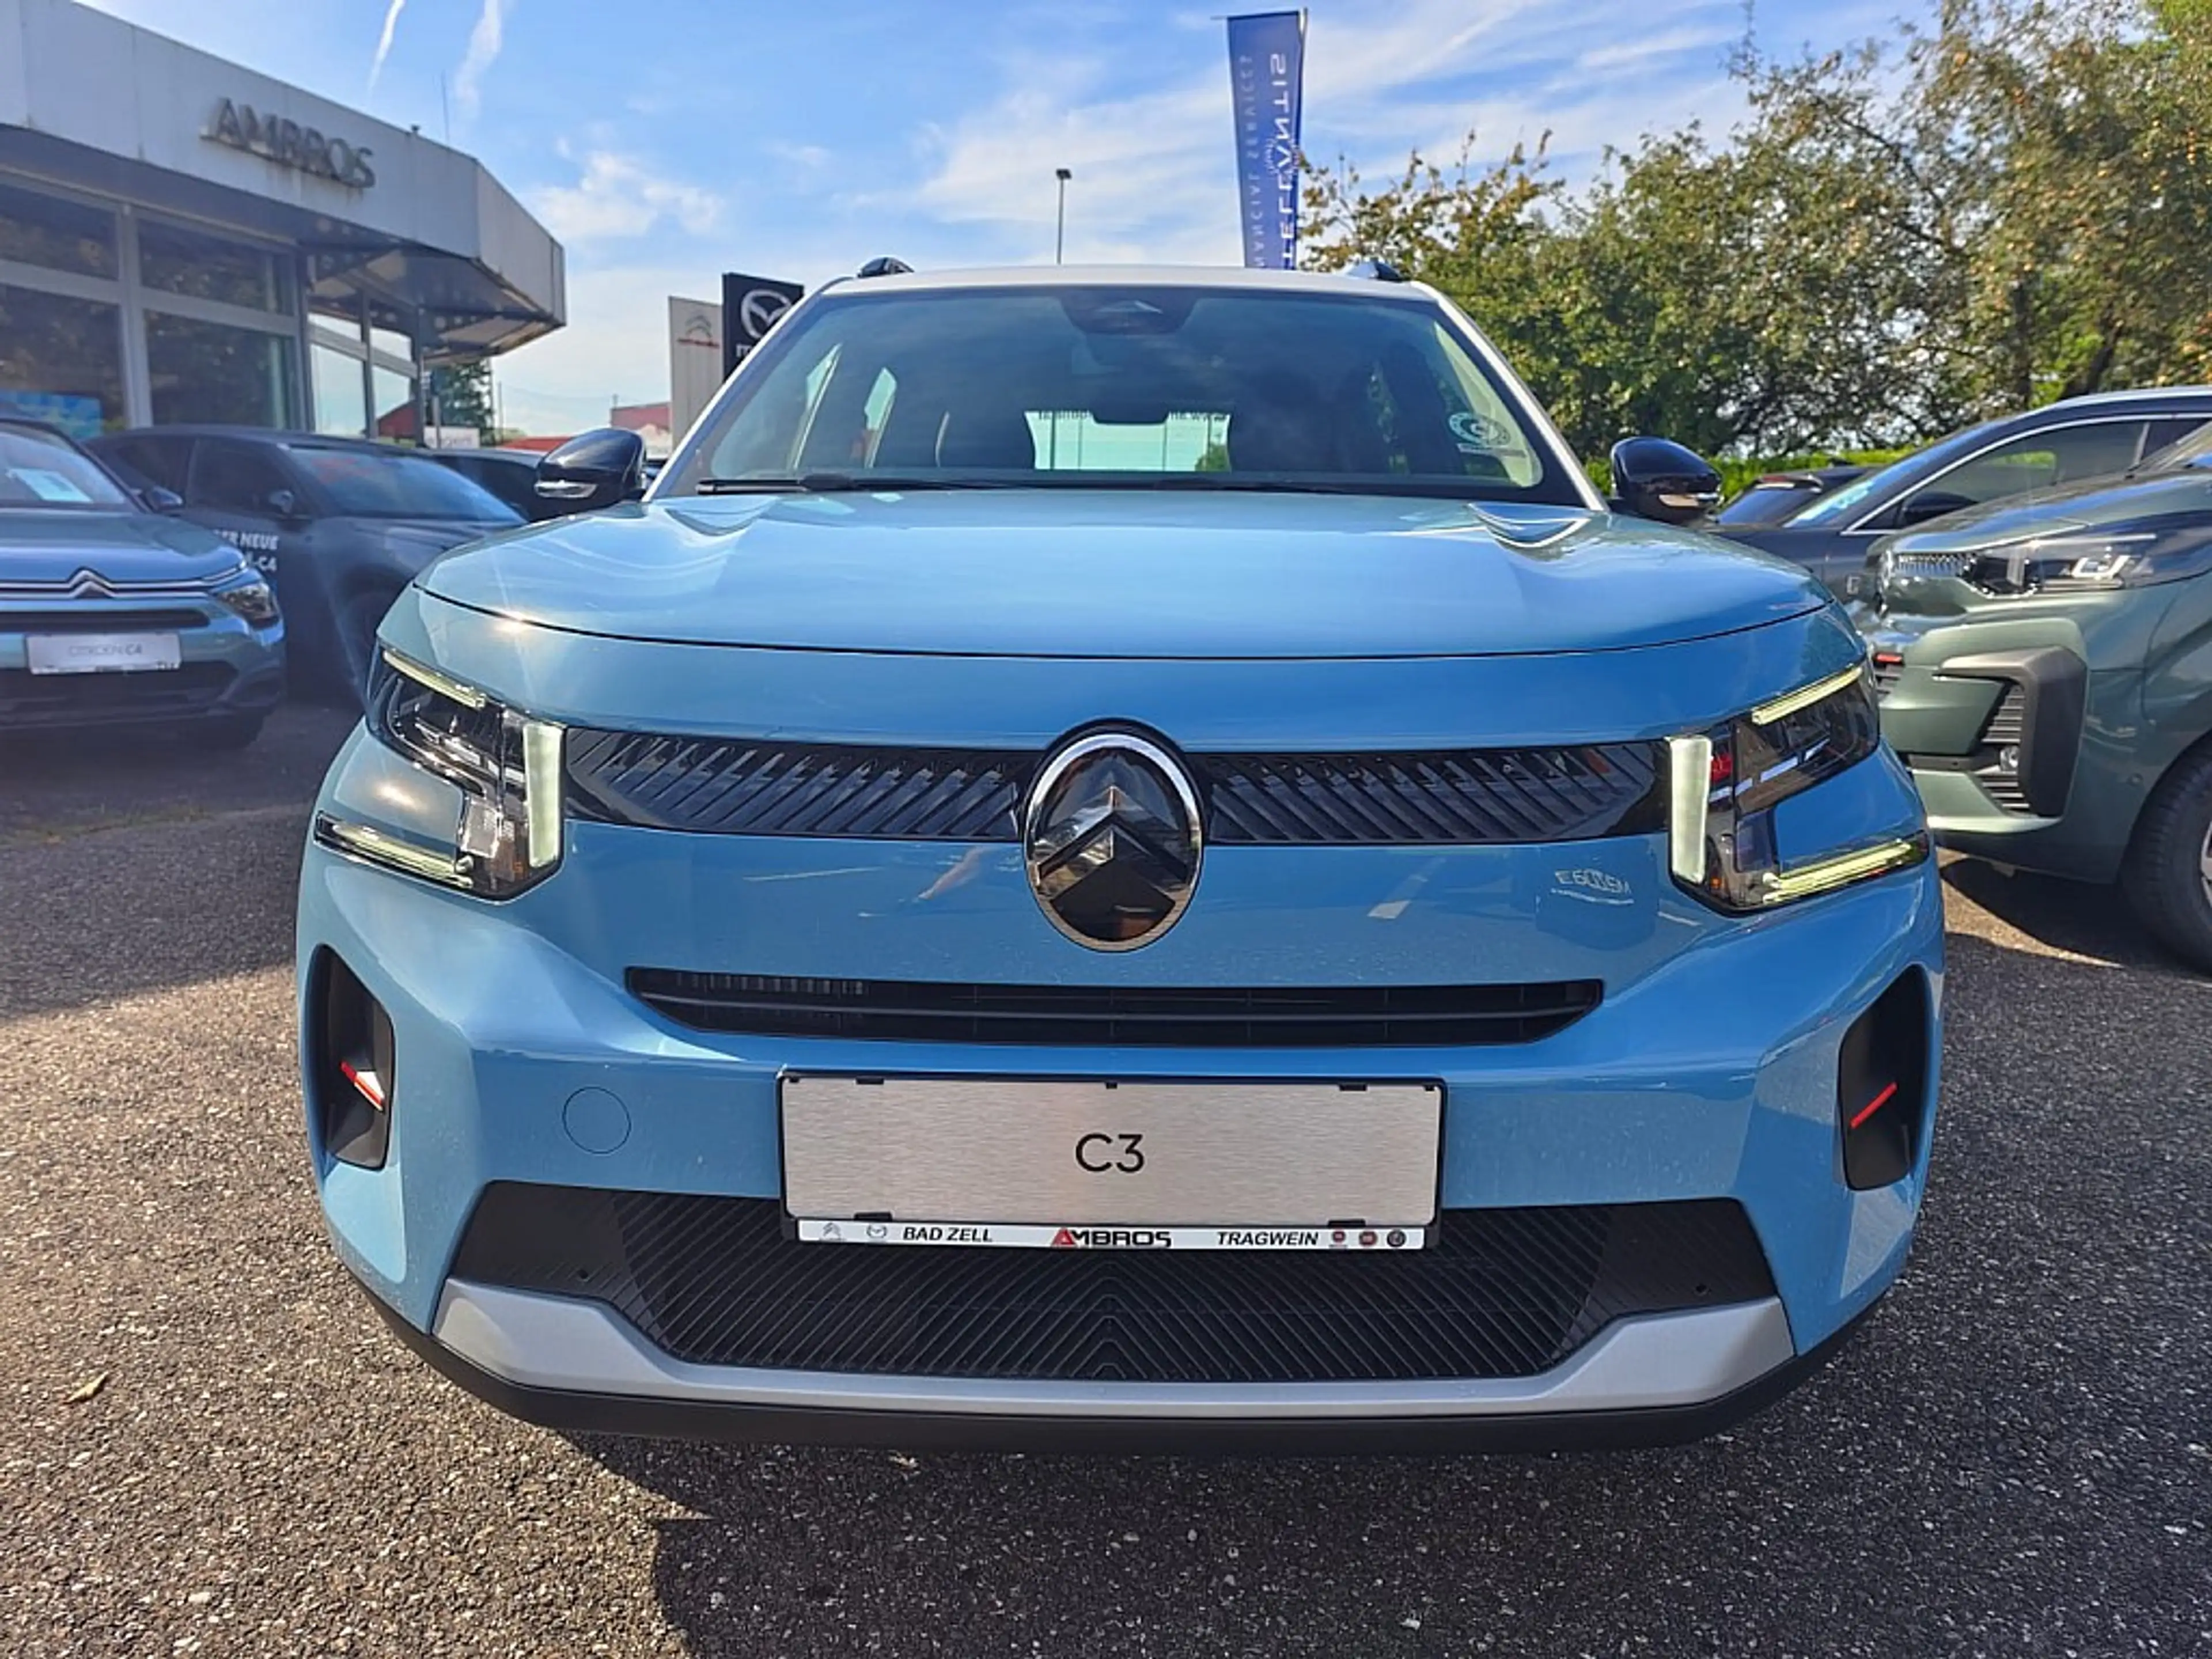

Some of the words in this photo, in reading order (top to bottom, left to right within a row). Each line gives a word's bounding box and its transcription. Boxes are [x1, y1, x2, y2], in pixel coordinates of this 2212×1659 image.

[205, 97, 376, 188] AMBROS
[240, 532, 279, 550] NEUE
[1076, 1132, 1144, 1173] C3
[902, 1226, 943, 1241] BAD
[946, 1228, 993, 1243] ZELL
[1051, 1227, 1172, 1248] AMBROS
[1217, 1231, 1319, 1246] TRAGWEIN
